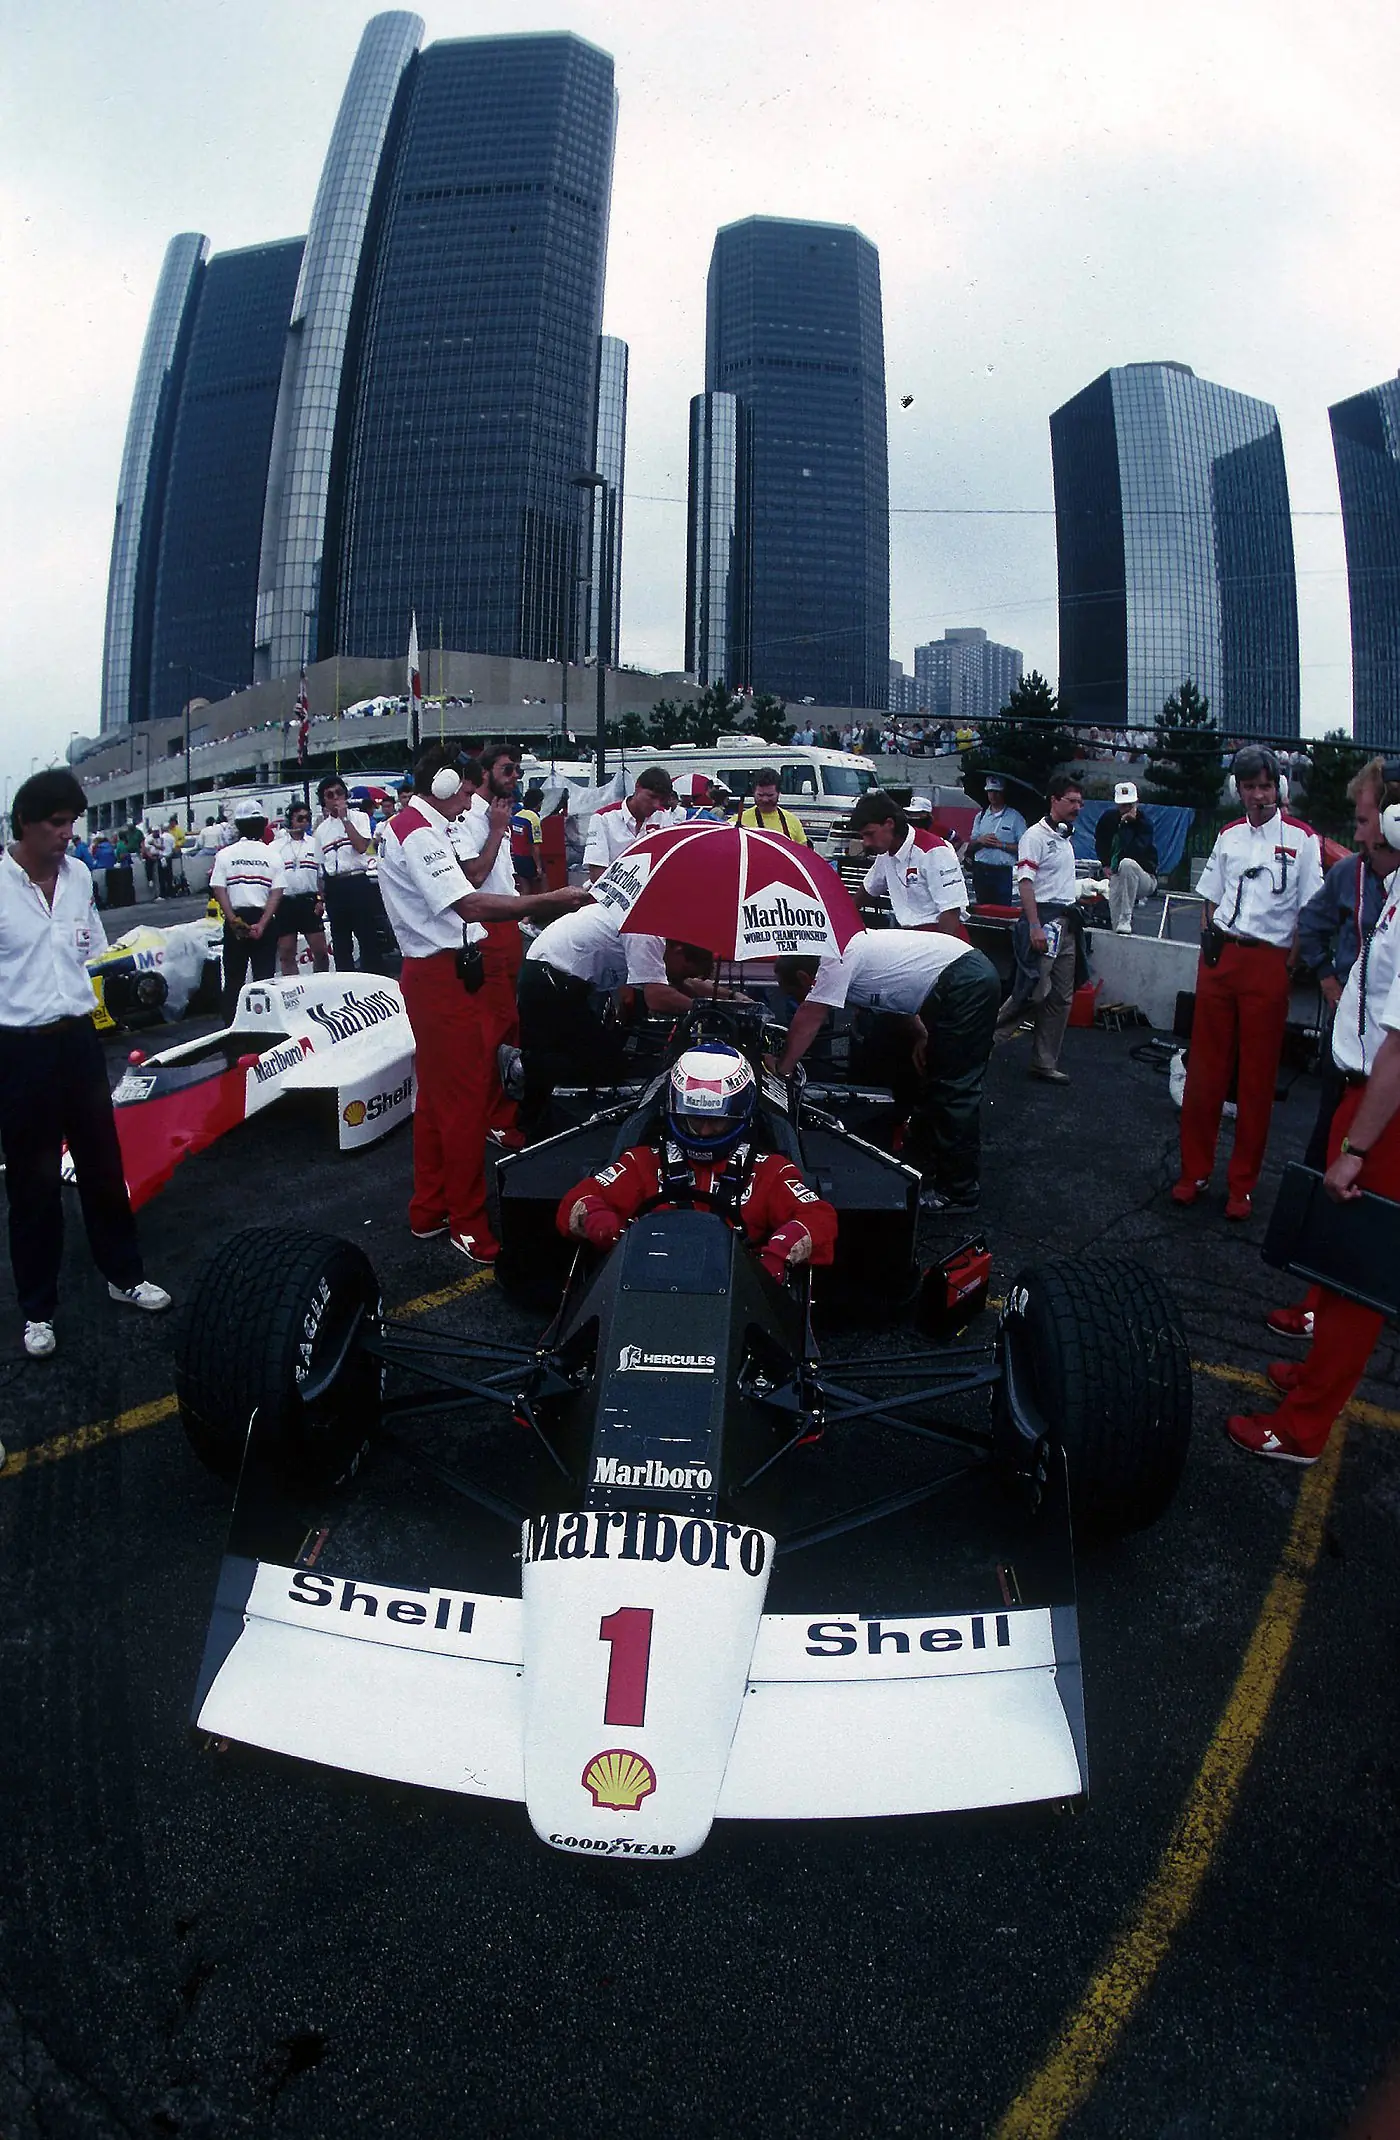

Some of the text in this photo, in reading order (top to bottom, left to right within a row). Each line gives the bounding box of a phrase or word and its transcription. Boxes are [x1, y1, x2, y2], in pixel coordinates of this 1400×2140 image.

[231, 859, 269, 868] HONDA
[742, 897, 826, 930] Marlboro
[743, 929, 828, 944] WORLD CHAMPIONSHIP
[776, 940, 798, 952] TEAM
[306, 990, 400, 1045] Marlboro
[254, 1045, 303, 1084] Marlboro
[367, 1076, 413, 1120] Shell
[685, 1094, 721, 1107] Marlboro
[643, 1353, 716, 1366] HERCULES
[593, 1456, 713, 1489] Marlboro
[523, 1511, 766, 1577] Marlboro
[288, 1570, 475, 1634] Shell
[805, 1614, 1010, 1657] Shell
[598, 1606, 654, 1728] 1
